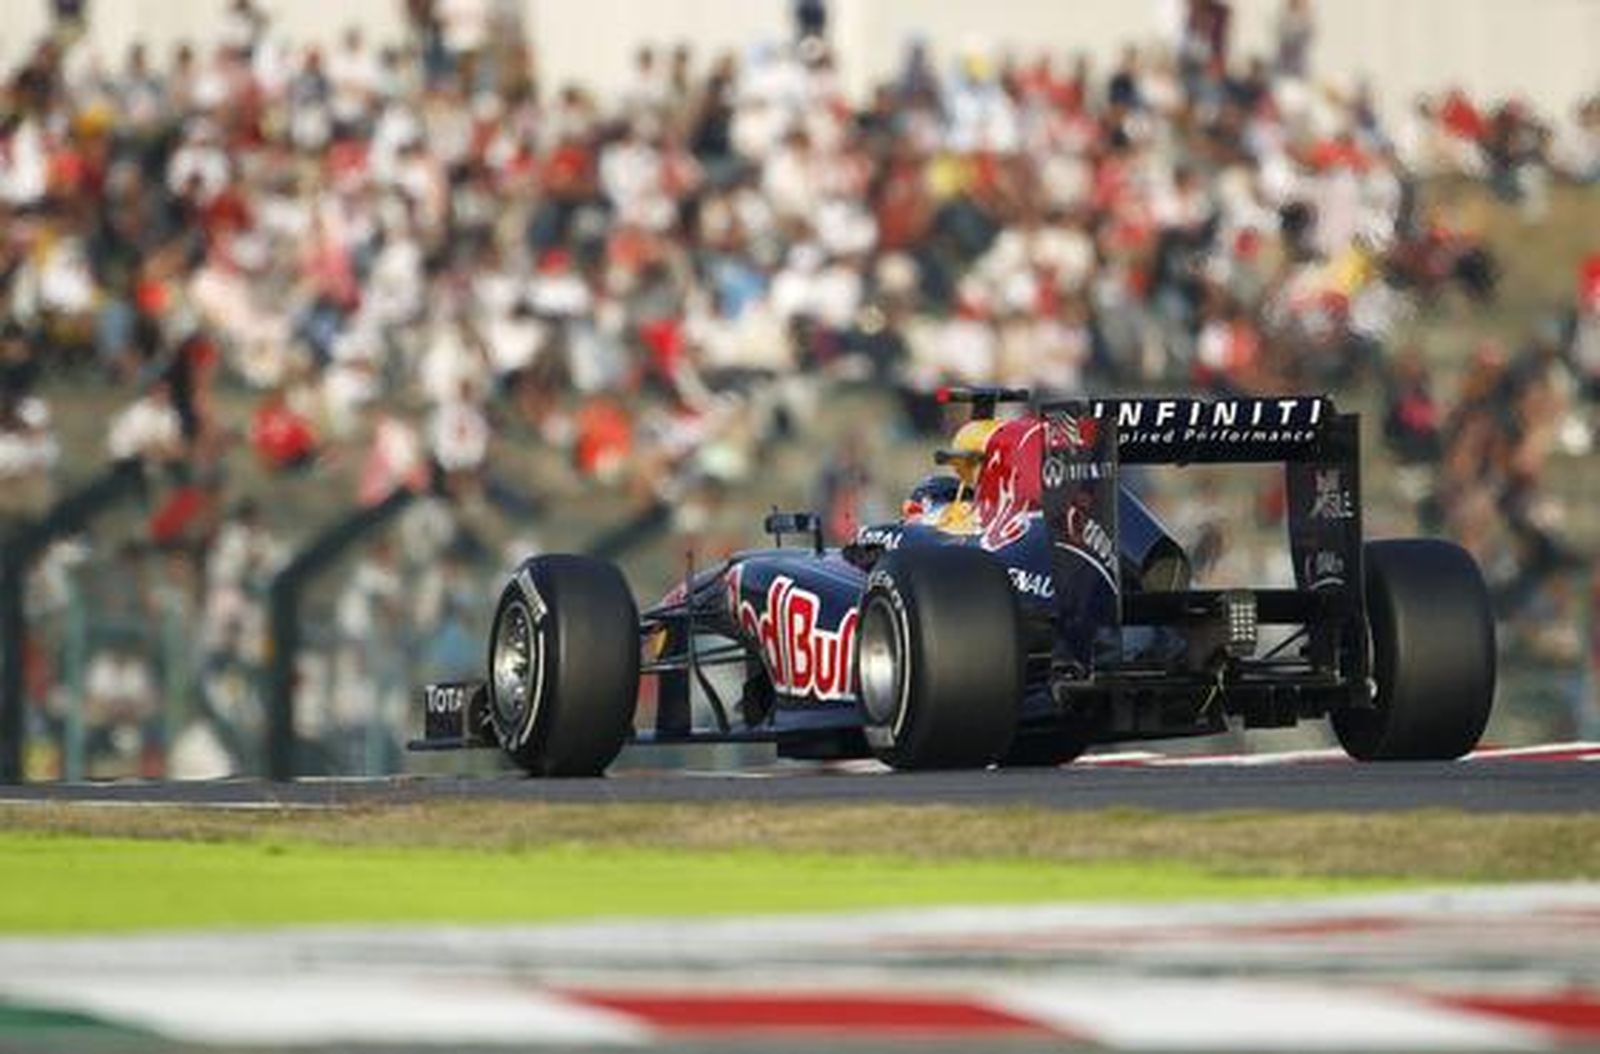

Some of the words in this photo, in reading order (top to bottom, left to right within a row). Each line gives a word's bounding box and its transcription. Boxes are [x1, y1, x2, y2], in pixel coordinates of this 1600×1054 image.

[1094, 400, 1322, 426] INFINITI
[1118, 429, 1175, 443] pired
[1184, 427, 1316, 441] Performance
